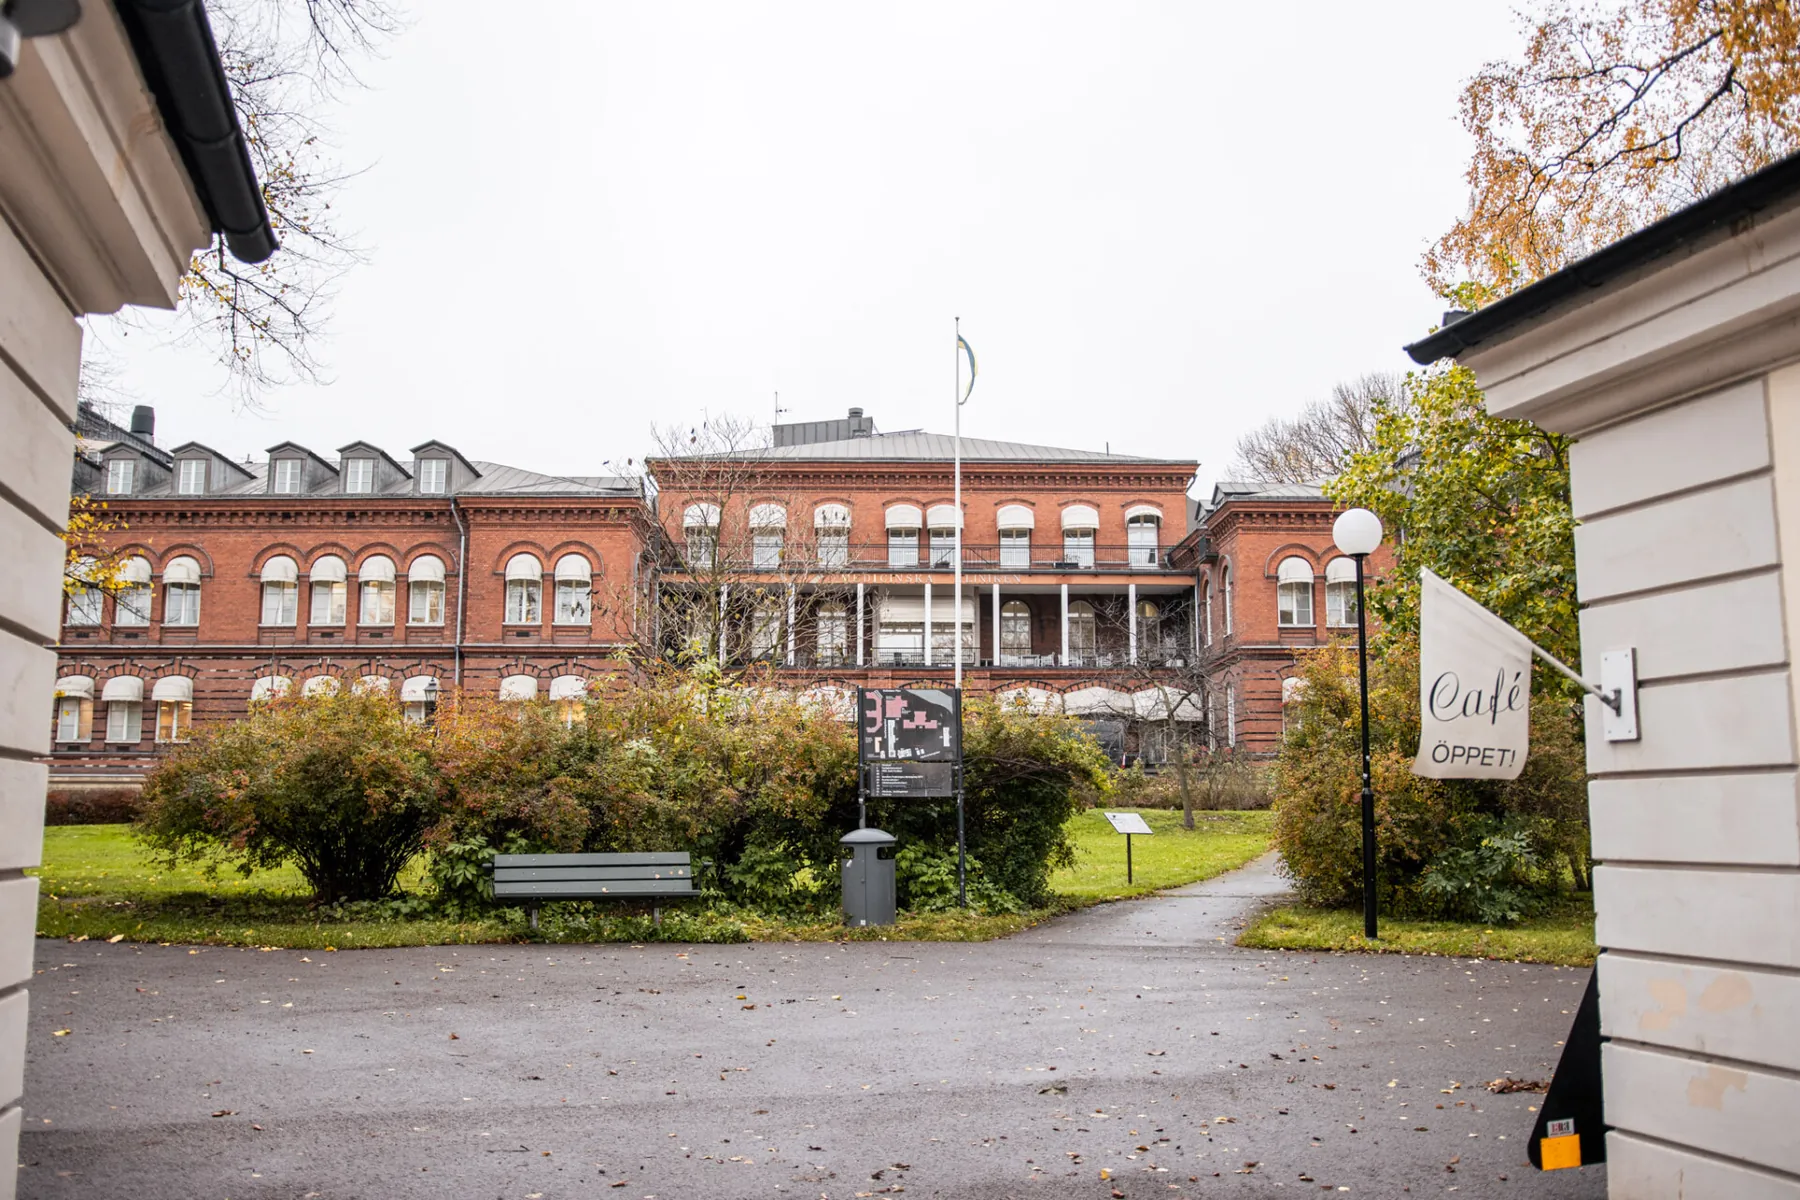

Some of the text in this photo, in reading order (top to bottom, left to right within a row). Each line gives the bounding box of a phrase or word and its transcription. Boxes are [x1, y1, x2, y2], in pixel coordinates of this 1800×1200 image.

[841, 573, 1022, 584] MEDICINSKA LINIKEN
[1429, 667, 1525, 726] Café
[1431, 740, 1517, 768] ÖPPET!
